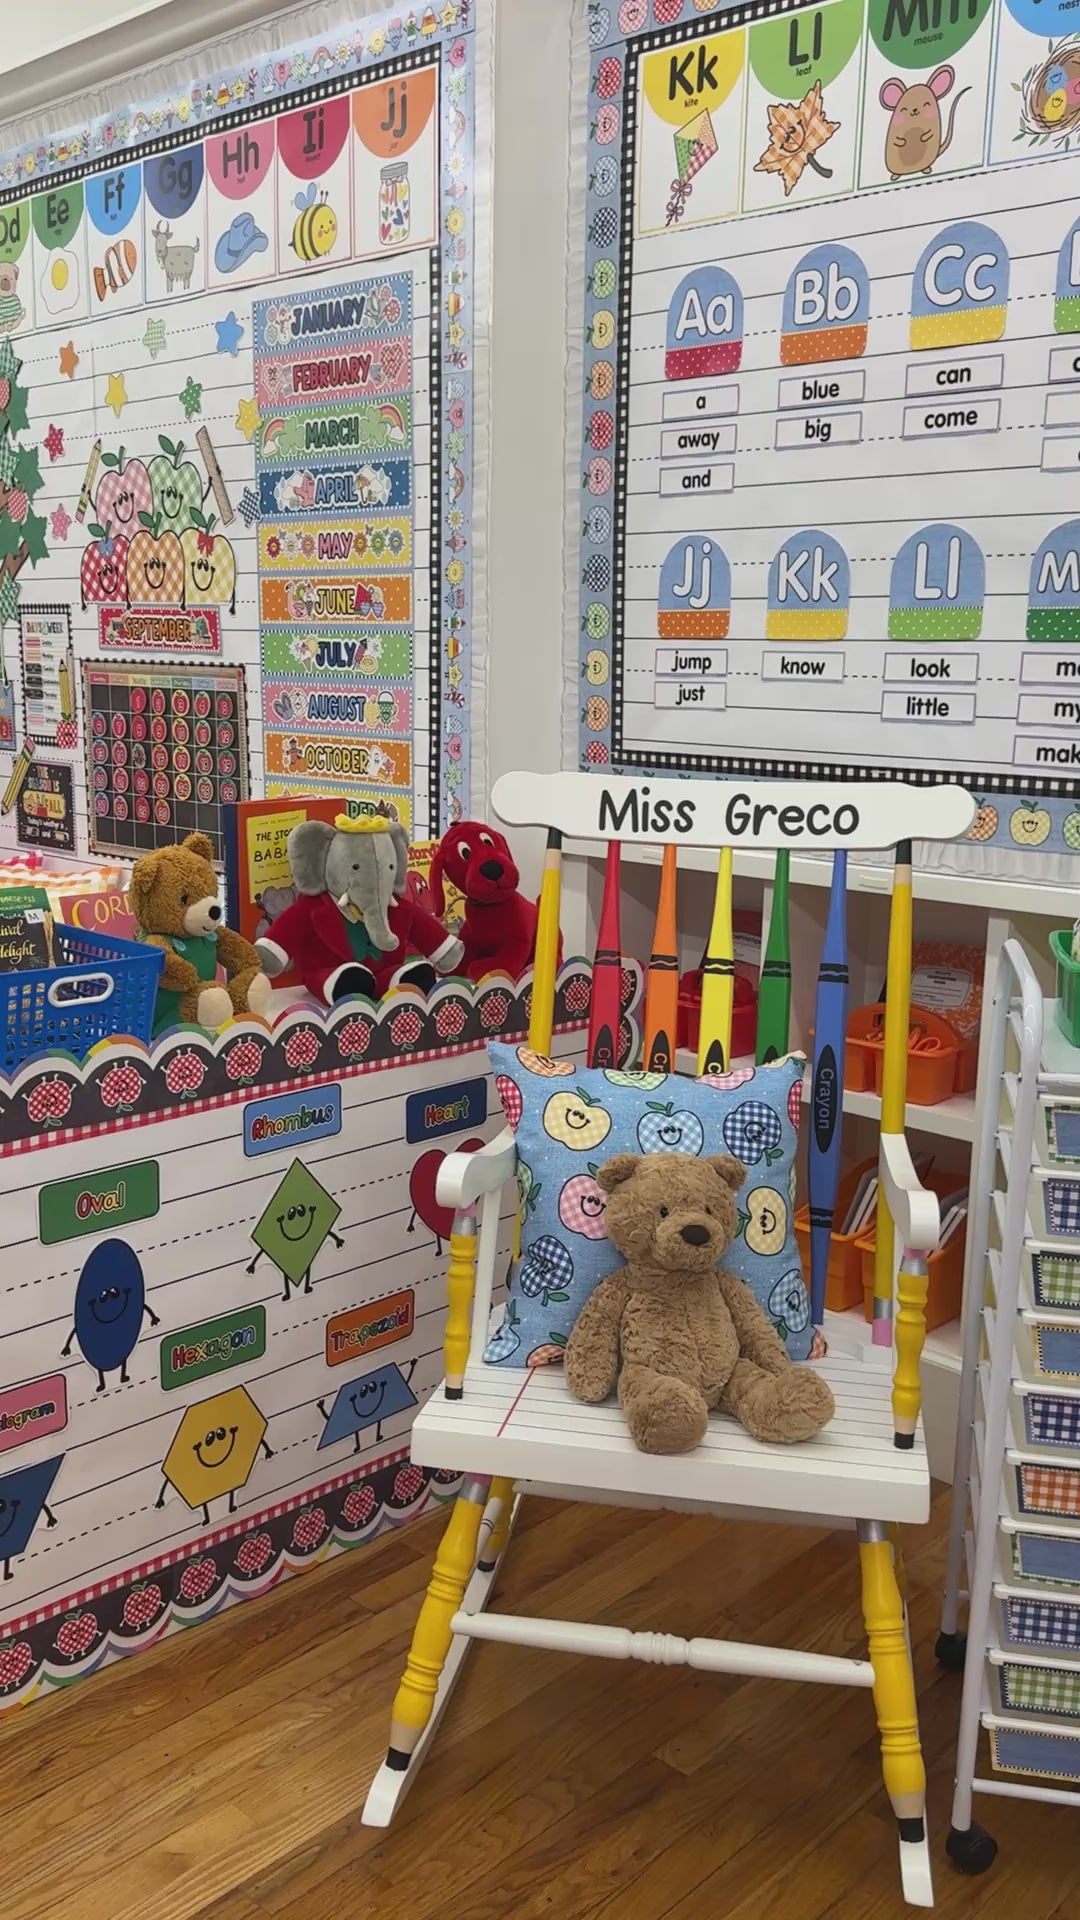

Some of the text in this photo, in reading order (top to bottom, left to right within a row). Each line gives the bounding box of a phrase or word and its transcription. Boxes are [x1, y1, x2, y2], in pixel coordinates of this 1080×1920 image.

[788, 11, 823, 67] Ll
[913, 32, 945, 47] mouse
[668, 44, 719, 101] Kk
[795, 64, 813, 77] leaf
[380, 80, 408, 139] Jj
[684, 97, 700, 109] kite
[303, 107, 325, 154] Ii
[222, 131, 260, 179] Hh
[104, 171, 126, 214] Ff
[159, 156, 193, 200] Gg
[46, 194, 70, 229] Ee
[923, 243, 998, 307] Cc
[793, 261, 860, 326] Bb
[291, 295, 366, 337] JANUARY
[675, 287, 735, 341] Aa
[292, 353, 372, 393] FEBRUARY
[936, 366, 972, 386] can
[695, 395, 706, 409] a
[802, 380, 840, 401] blue
[305, 415, 359, 450] MARCH
[804, 418, 832, 442] big
[924, 409, 978, 429] come
[678, 431, 720, 451] away
[315, 474, 359, 505] APRIL
[681, 469, 711, 490] and
[318, 531, 354, 560] MAY
[672, 540, 713, 609] Jj
[777, 545, 840, 603] Kk
[913, 535, 962, 600] Ll
[1036, 550, 1080, 594] M
[314, 588, 356, 615] JUNE
[124, 616, 192, 643] SEPTEMBER
[315, 640, 357, 668] JULY
[671, 650, 712, 675] jump
[780, 655, 826, 675] know
[910, 658, 951, 678] look
[307, 693, 366, 723] AUGUST
[675, 684, 706, 705] just
[906, 695, 950, 717] little
[304, 744, 369, 775] OCTOBER
[1035, 743, 1080, 764] mak
[349, 800, 377, 819] BER
[598, 786, 860, 837] Miss Greco
[255, 828, 293, 842] THE STO
[0, 919, 25, 937] ival
[28, 912, 39, 921] M
[0, 940, 36, 965] lelight
[424, 1095, 470, 1129] Heart
[815, 1068, 834, 1129] Crayon
[251, 1104, 335, 1142] Rhombus
[76, 1181, 126, 1220] Oval
[330, 1303, 410, 1353] Trapezoid
[171, 1325, 257, 1372] Hexagon
[0, 1401, 57, 1432] logram
